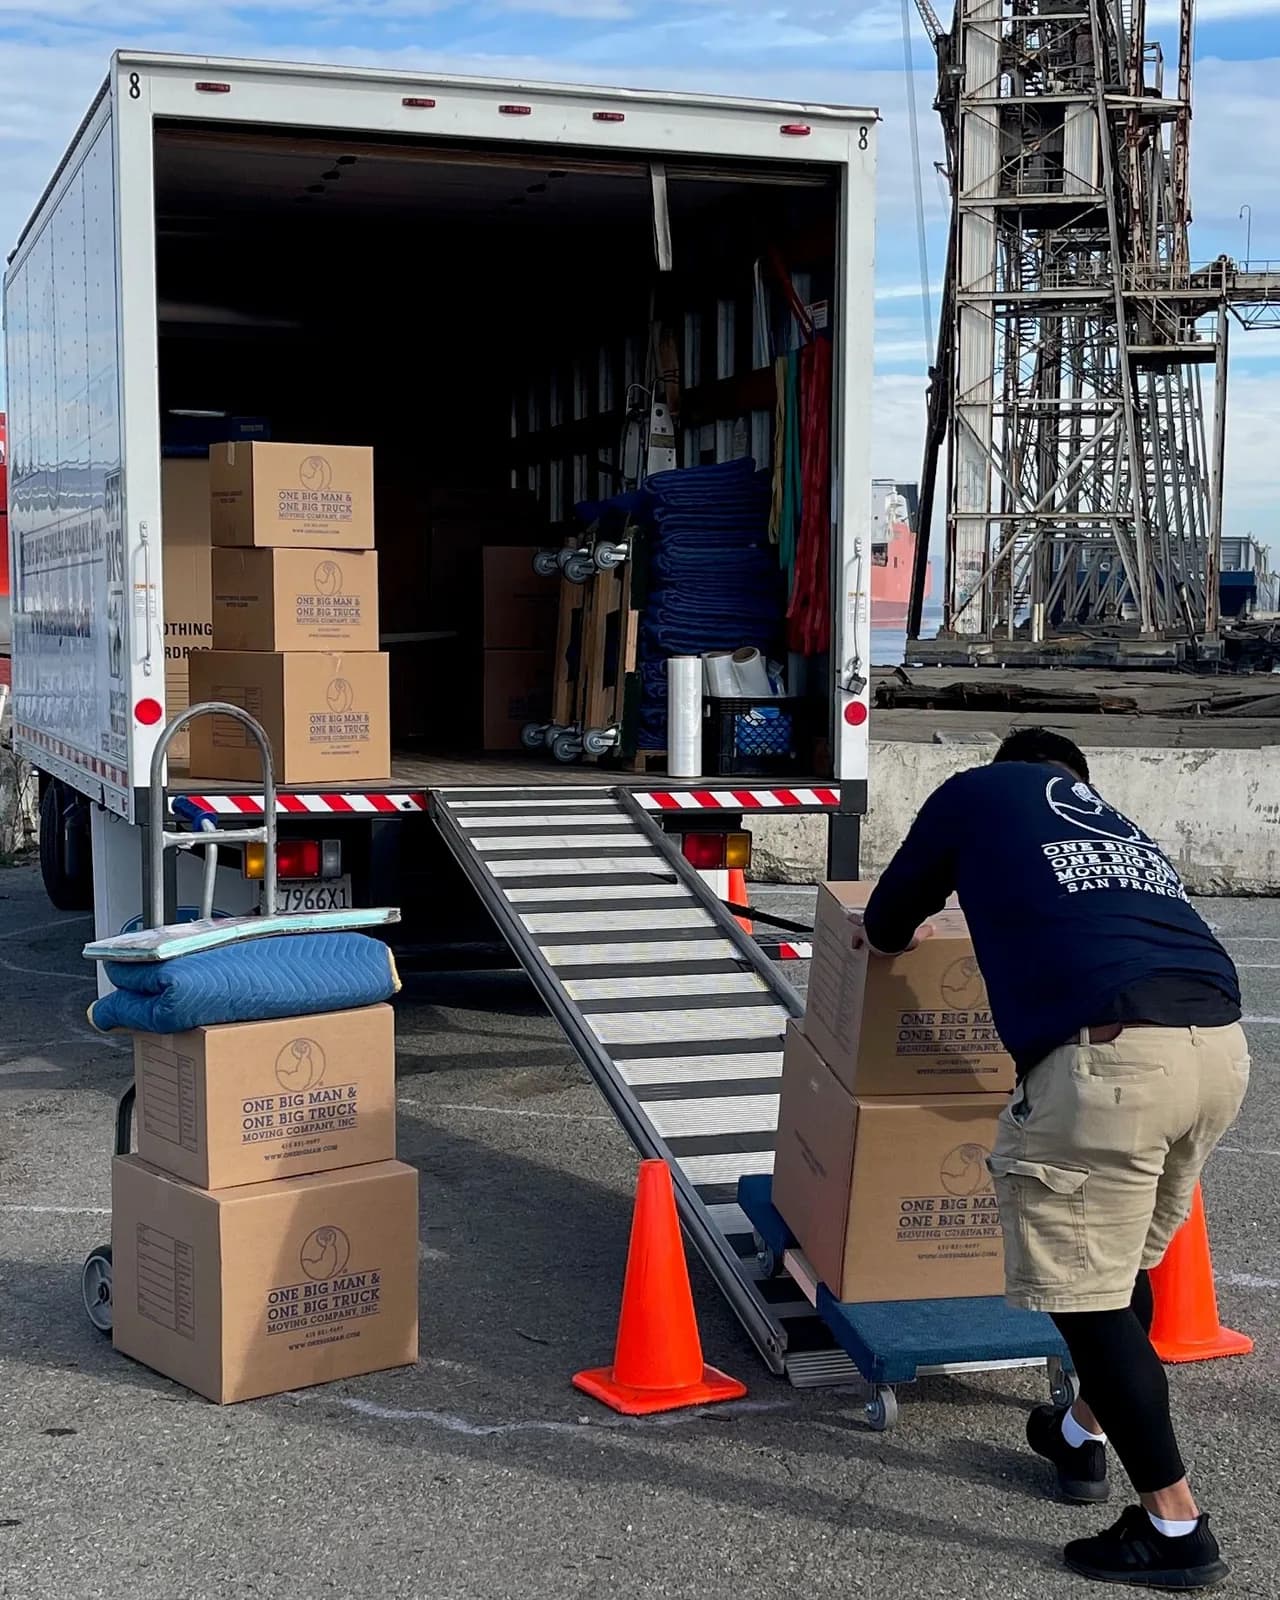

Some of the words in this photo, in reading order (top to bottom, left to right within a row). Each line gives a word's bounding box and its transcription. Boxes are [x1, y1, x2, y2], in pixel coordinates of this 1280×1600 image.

[129, 72, 141, 99] 8
[858, 126, 868, 150] 8
[278, 491, 299, 500] ONE
[302, 492, 318, 500] BIG
[321, 493, 343, 501] MAN
[346, 494, 352, 502] &
[278, 502, 299, 510] ONE
[302, 502, 318, 511] BIG
[321, 504, 352, 513] TRUCK
[296, 596, 314, 605] ONE
[316, 597, 332, 605] BIG
[333, 597, 352, 606] MAN
[354, 598, 360, 606] &
[296, 607, 314, 616] ONE
[316, 608, 332, 616] BIG
[333, 608, 360, 616] TRUCK
[310, 714, 327, 723] ONE
[329, 714, 342, 722] BIG
[344, 714, 362, 722] MAN
[310, 726, 327, 734] ONE
[329, 725, 342, 733] BIG
[344, 724, 369, 733] TRUCK
[1043, 842, 1094, 857] ONE
[1102, 842, 1139, 857] BIG
[1051, 853, 1101, 868] ONE
[1109, 853, 1146, 870] BIG
[1055, 865, 1139, 882] MOVING
[1066, 878, 1110, 894] SAN
[280, 887, 350, 911] 7966X1
[901, 1013, 936, 1025] ONE
[940, 1012, 968, 1024] BIG
[898, 1030, 934, 1041] ONE
[938, 1029, 966, 1040] BIG
[896, 1044, 941, 1053] MOVING
[242, 1098, 274, 1114] ONE
[279, 1094, 304, 1108] BIG
[308, 1088, 343, 1104] MAN
[347, 1086, 357, 1098] &
[242, 1114, 274, 1130] ONE
[279, 1110, 304, 1125] BIG
[308, 1102, 357, 1120] TRUCK
[242, 1128, 284, 1142] MOVING
[900, 1200, 934, 1212] ONE
[940, 1198, 968, 1210] BIG
[898, 1216, 933, 1228] ONE
[938, 1214, 966, 1226] BIG
[896, 1230, 942, 1240] MOVING
[268, 1288, 299, 1304] ONE
[304, 1282, 328, 1298] BIG
[333, 1275, 366, 1292] MAN
[370, 1272, 380, 1284] &
[268, 1304, 298, 1320] ONE
[304, 1298, 328, 1314] BIG
[332, 1288, 380, 1308] TRUCK
[267, 1318, 308, 1333] MOVING
